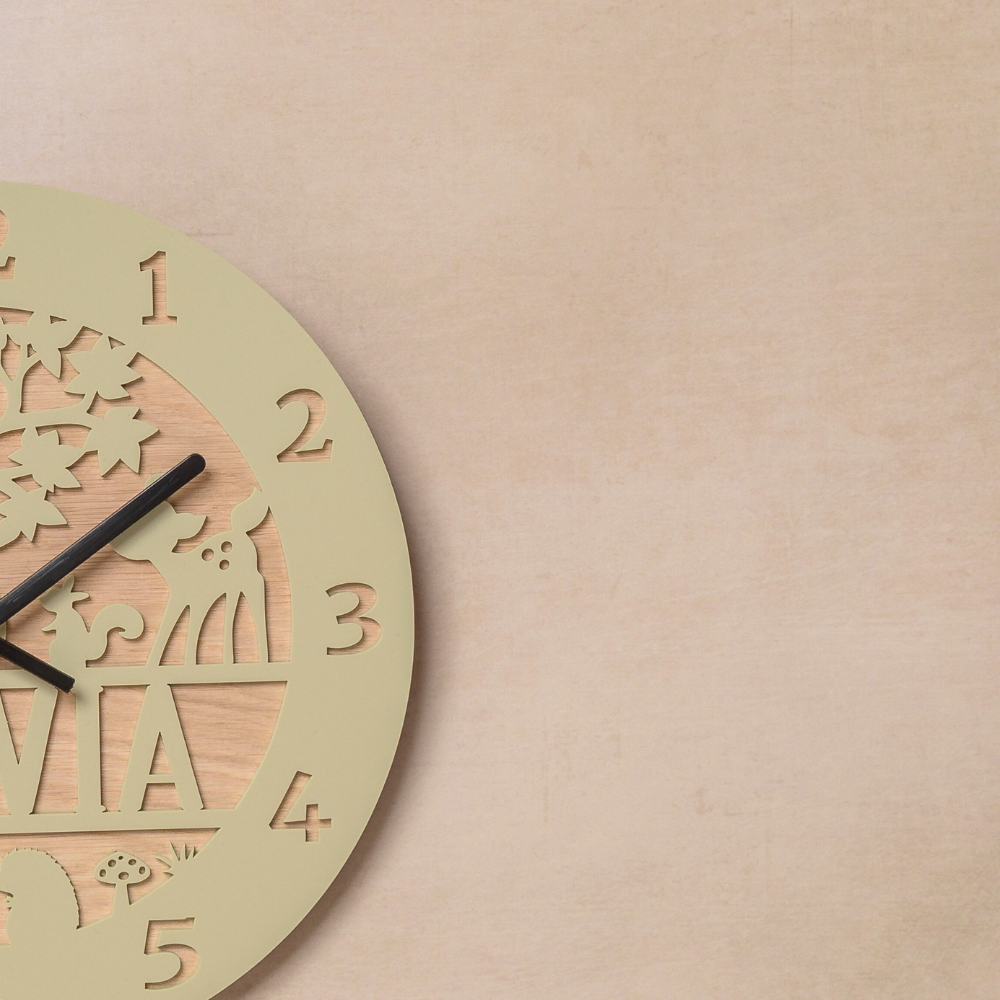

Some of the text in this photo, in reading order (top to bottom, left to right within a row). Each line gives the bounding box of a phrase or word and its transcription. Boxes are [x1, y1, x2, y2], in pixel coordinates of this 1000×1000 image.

[139, 250, 178, 325] 1
[276, 388, 333, 463] 2
[325, 582, 383, 656] 3
[269, 770, 332, 842] 4
[144, 917, 199, 990] 5
